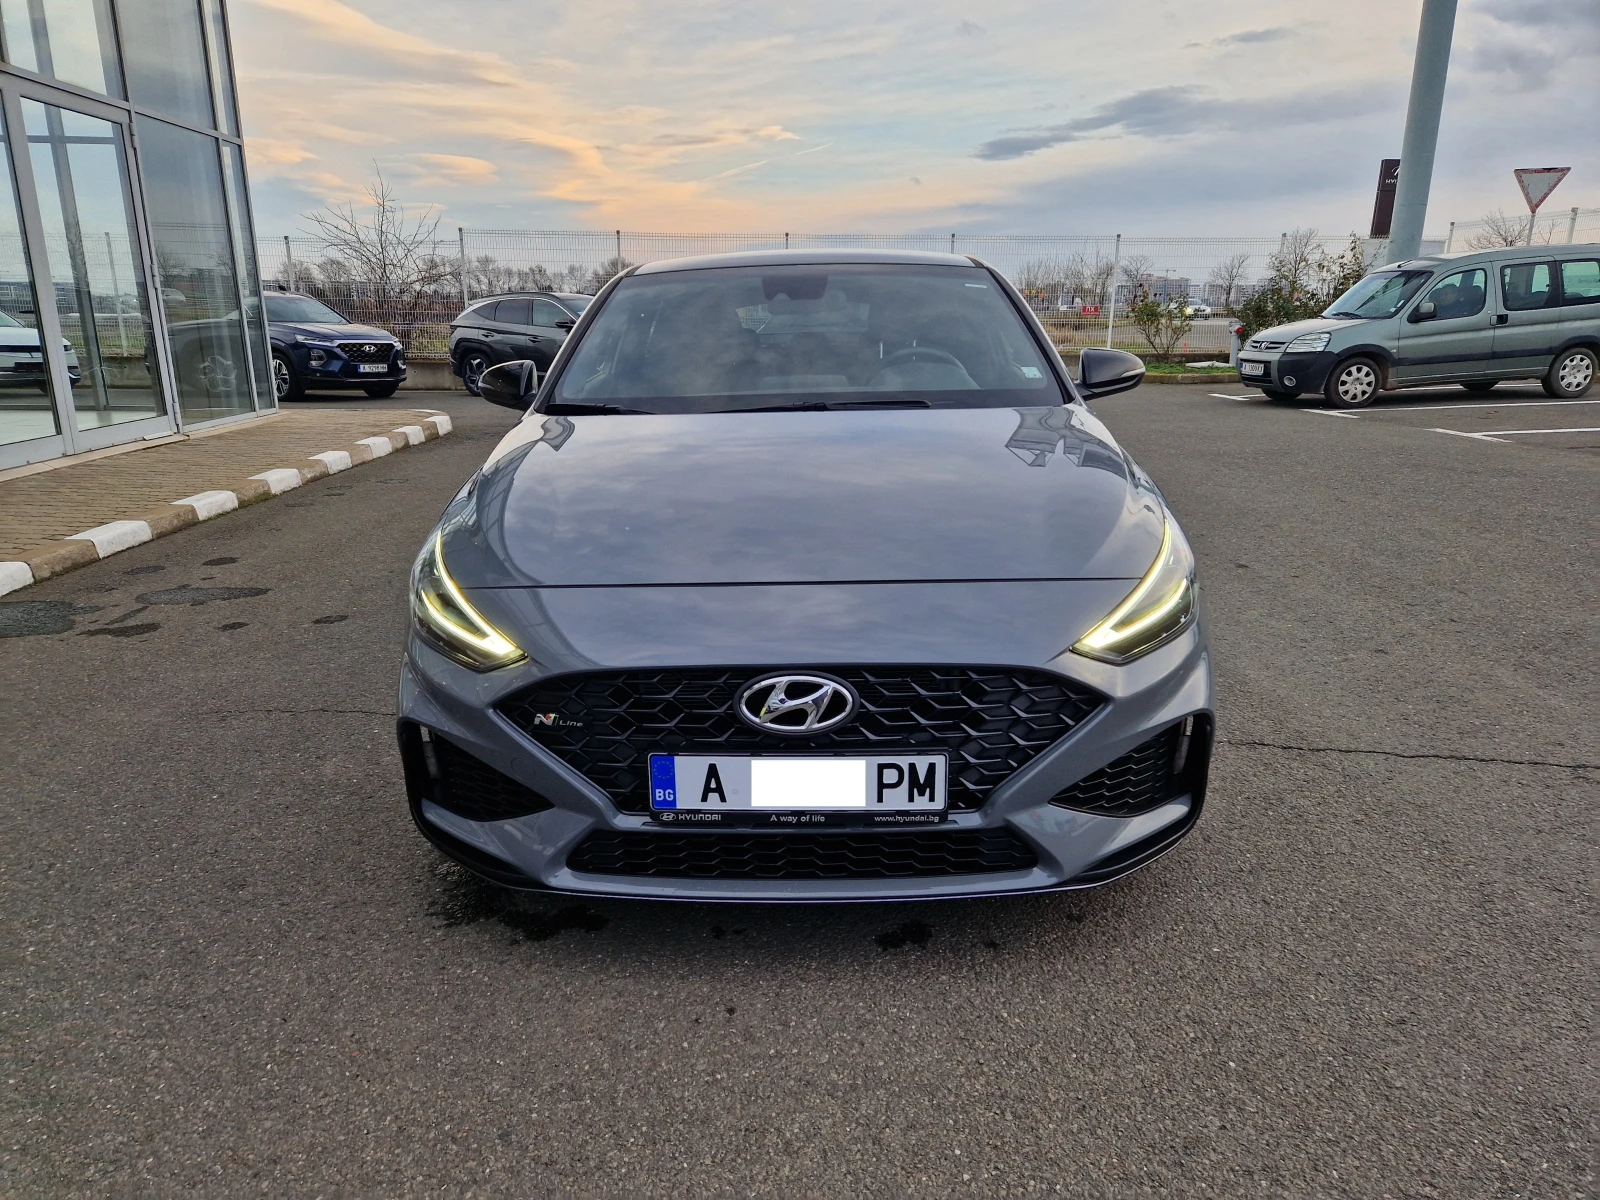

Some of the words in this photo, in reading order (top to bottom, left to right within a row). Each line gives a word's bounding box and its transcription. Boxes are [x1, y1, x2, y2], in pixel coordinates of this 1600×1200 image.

[700, 763, 727, 803] A
[876, 762, 936, 803] PM
[655, 789, 674, 801] BG
[780, 816, 797, 824] way
[874, 815, 940, 823] www.hyundai.bg
